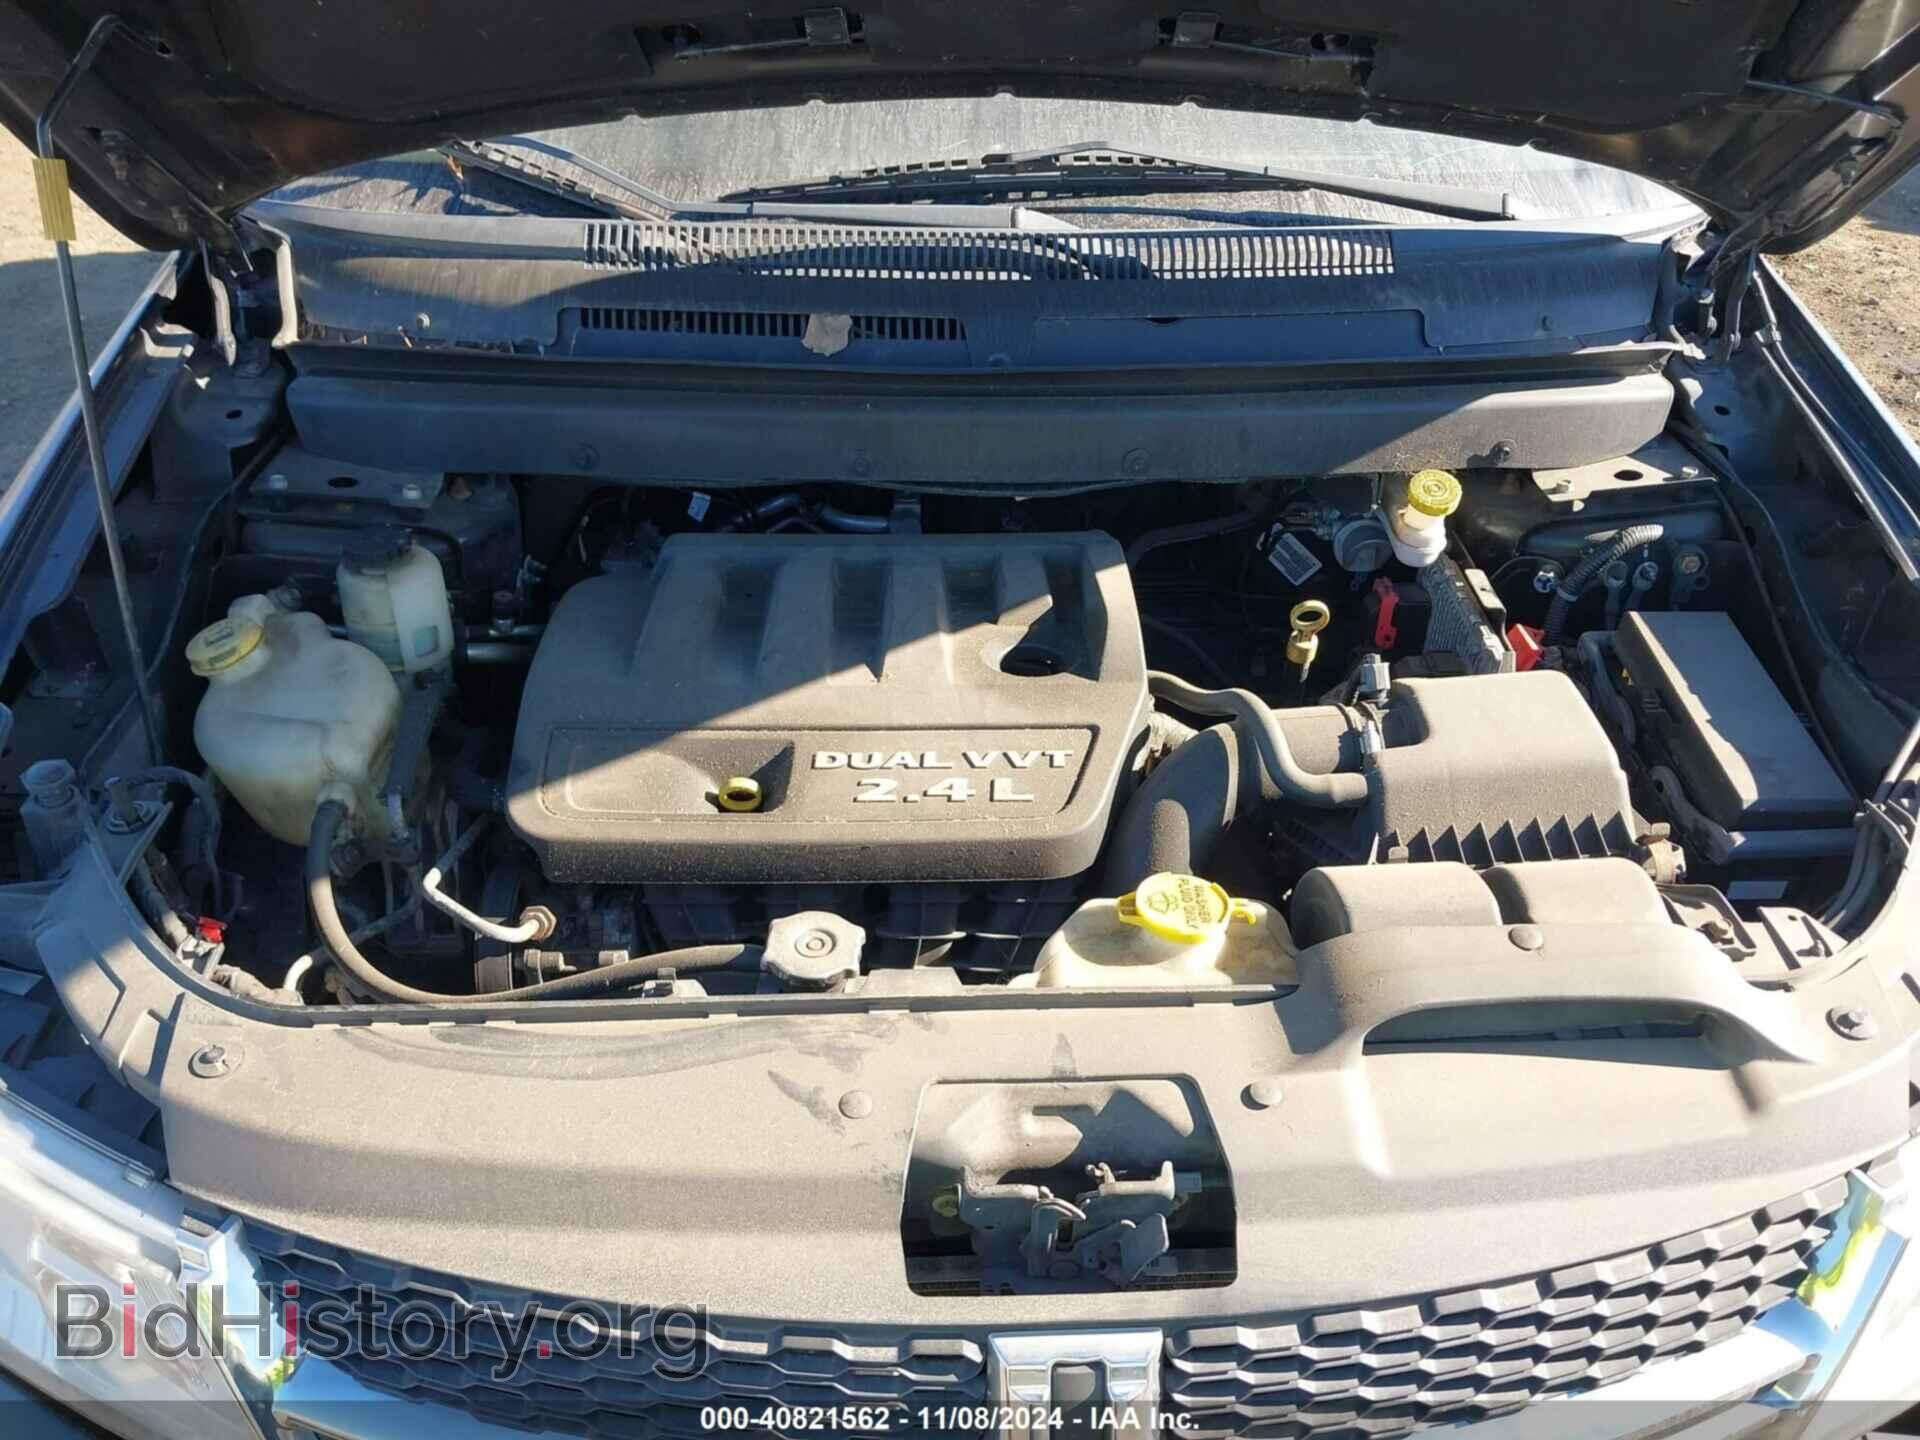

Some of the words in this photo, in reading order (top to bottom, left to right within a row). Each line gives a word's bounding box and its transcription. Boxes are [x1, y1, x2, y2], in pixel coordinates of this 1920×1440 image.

[811, 750, 953, 769] DUAL
[961, 750, 1074, 769] VVT
[1177, 877, 1194, 904] FLUID
[1183, 904, 1199, 930] ONLY
[1192, 883, 1213, 925] WASHER
